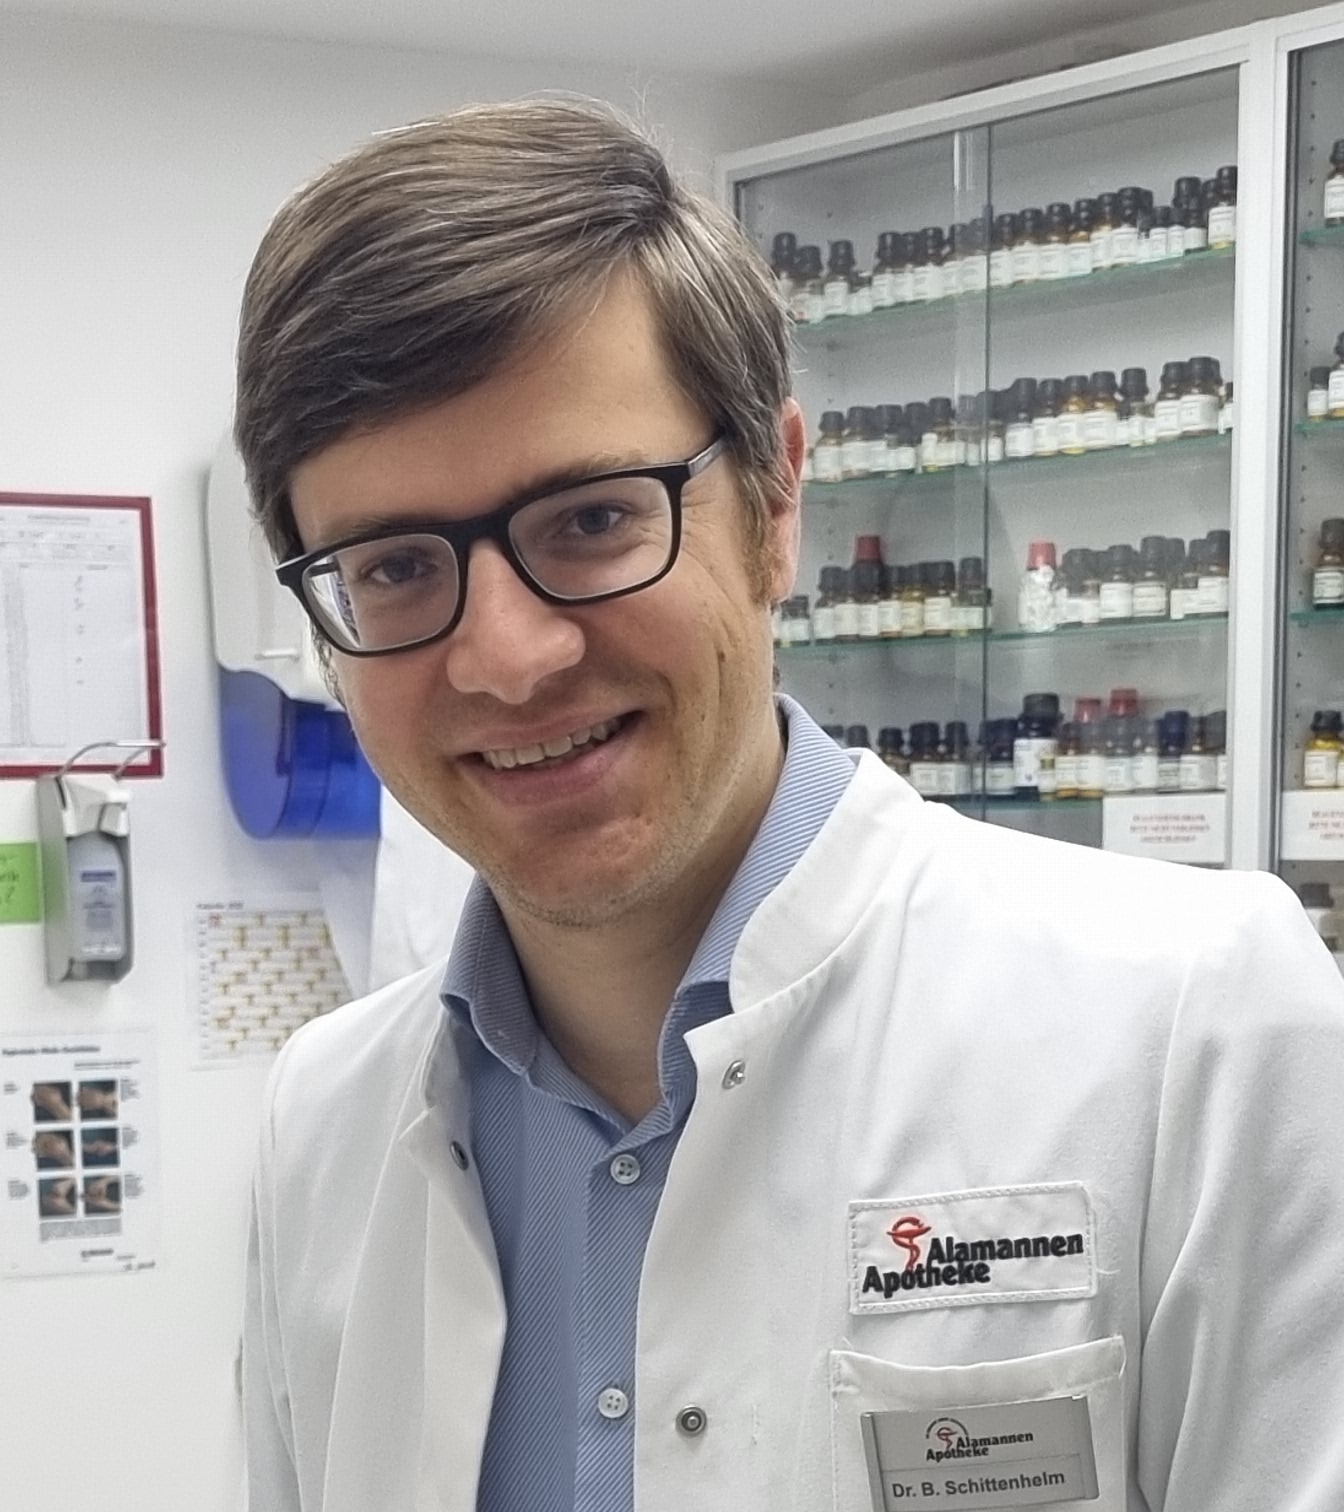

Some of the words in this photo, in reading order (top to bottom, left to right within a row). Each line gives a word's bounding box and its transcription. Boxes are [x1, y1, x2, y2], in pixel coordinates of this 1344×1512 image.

[926, 1233, 1084, 1265] Alamannen
[862, 1261, 991, 1298] Apotheke
[956, 1430, 1033, 1449] Alamannen
[926, 1445, 989, 1463] Apotheke
[892, 1481, 917, 1499] Dr.
[921, 1482, 940, 1497] B.
[945, 1471, 1066, 1496] Schittenhelm
